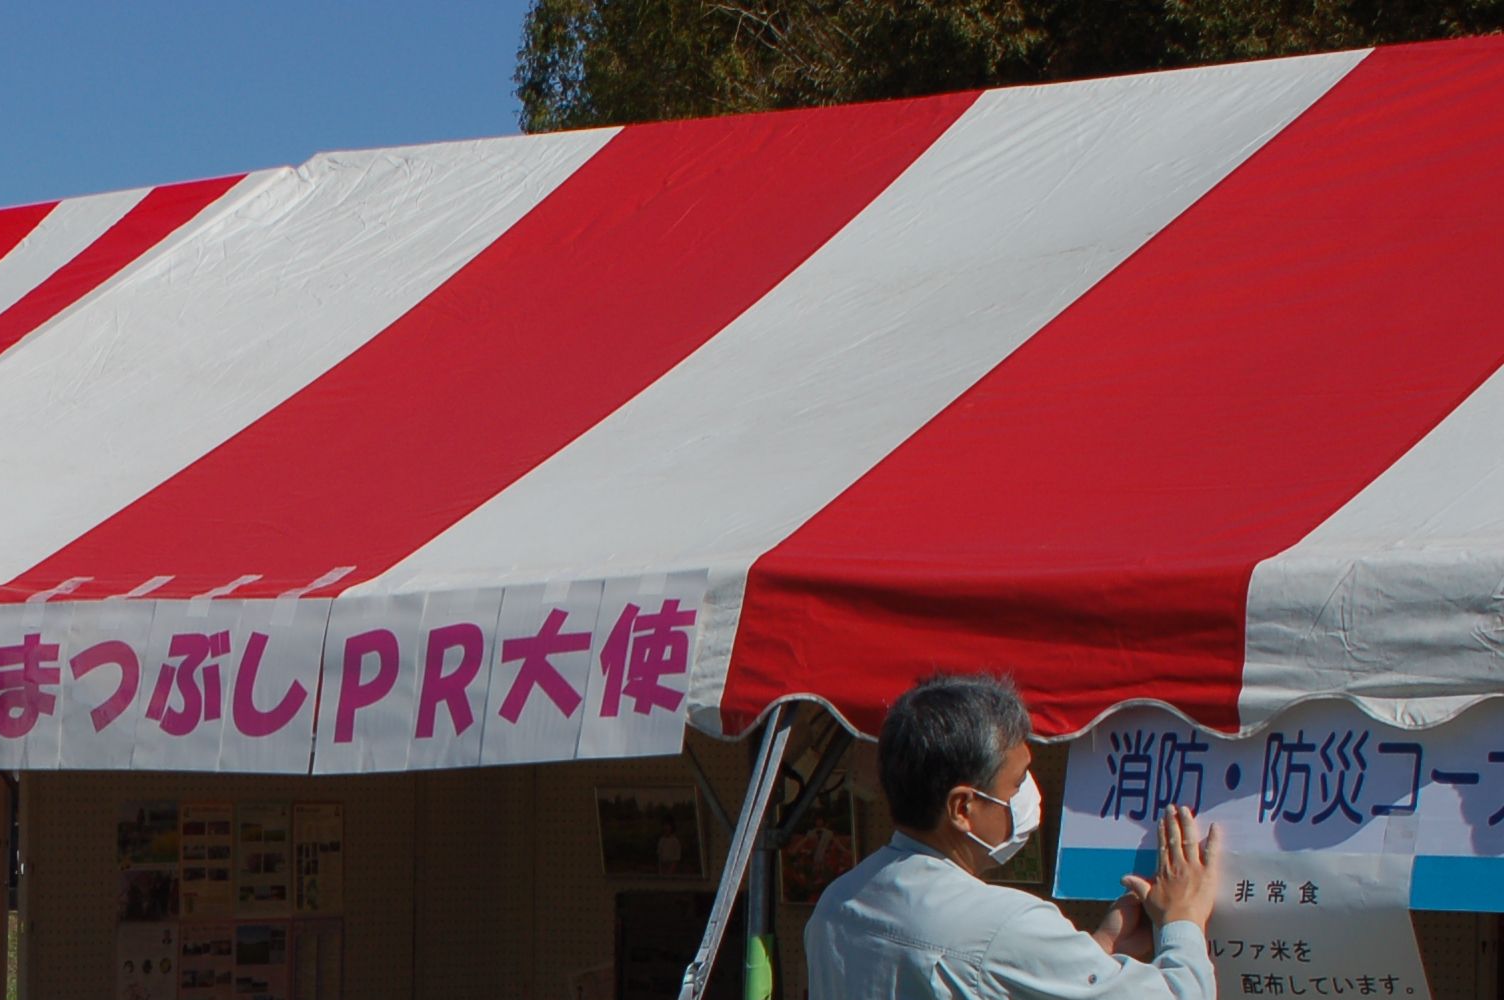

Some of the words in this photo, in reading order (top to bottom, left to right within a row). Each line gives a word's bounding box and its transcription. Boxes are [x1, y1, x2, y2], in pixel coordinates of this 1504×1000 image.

[1234, 880, 1319, 904] 非常食
[1241, 973, 1414, 995] 配布しています。
